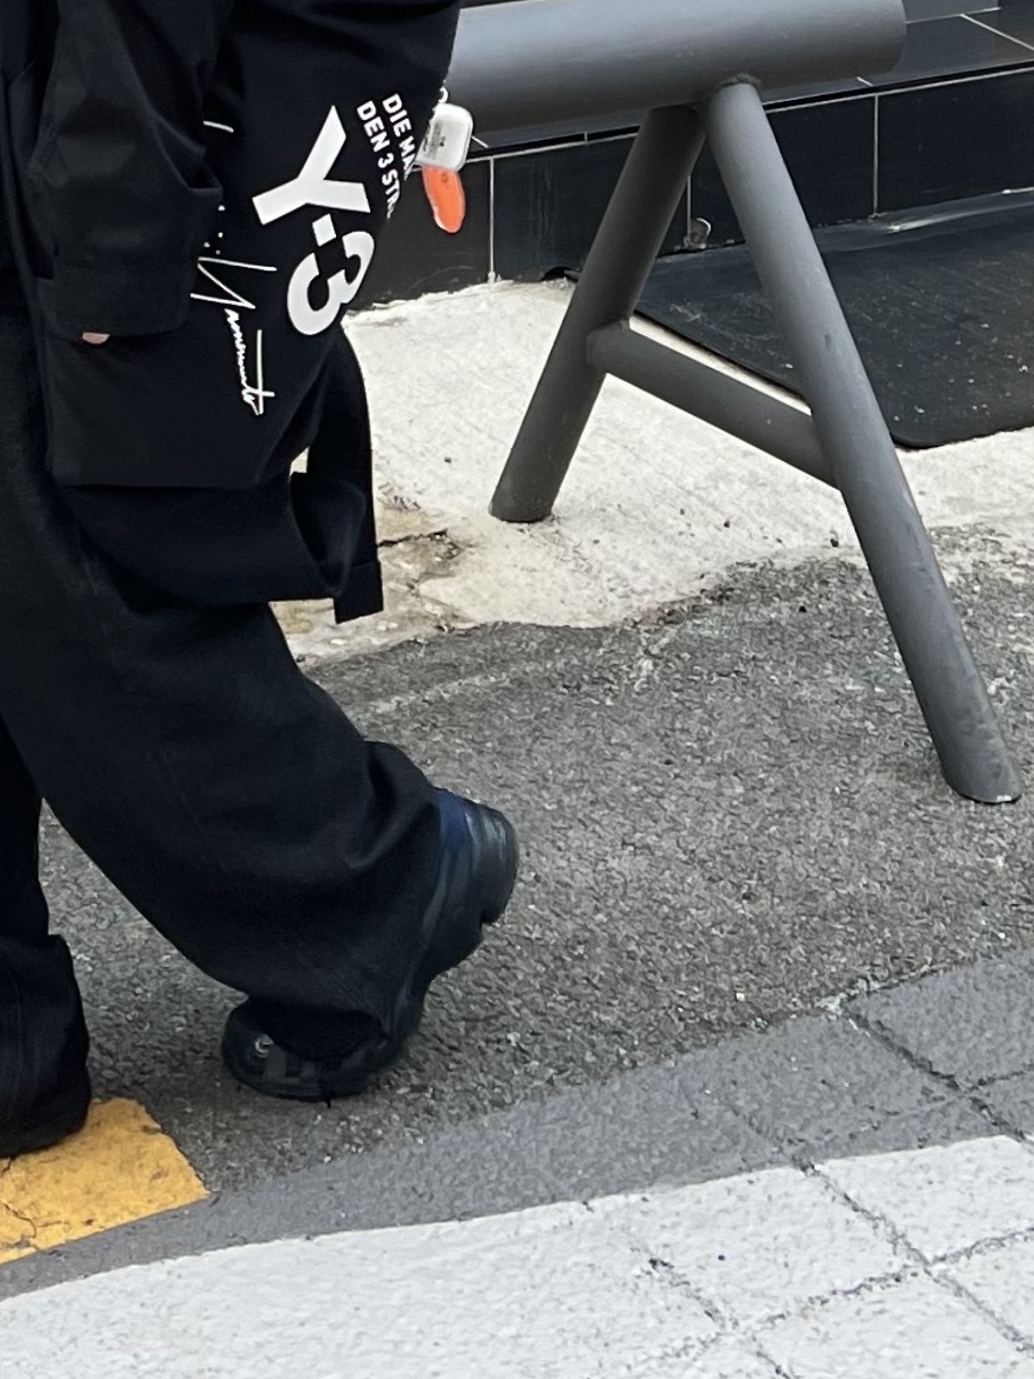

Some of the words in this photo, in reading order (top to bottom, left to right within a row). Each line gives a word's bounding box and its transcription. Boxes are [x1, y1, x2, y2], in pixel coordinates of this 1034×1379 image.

[356, 100, 391, 153] DEN
[377, 152, 396, 169] 3
[382, 92, 413, 138] DIE
[252, 105, 375, 336] Y-3
